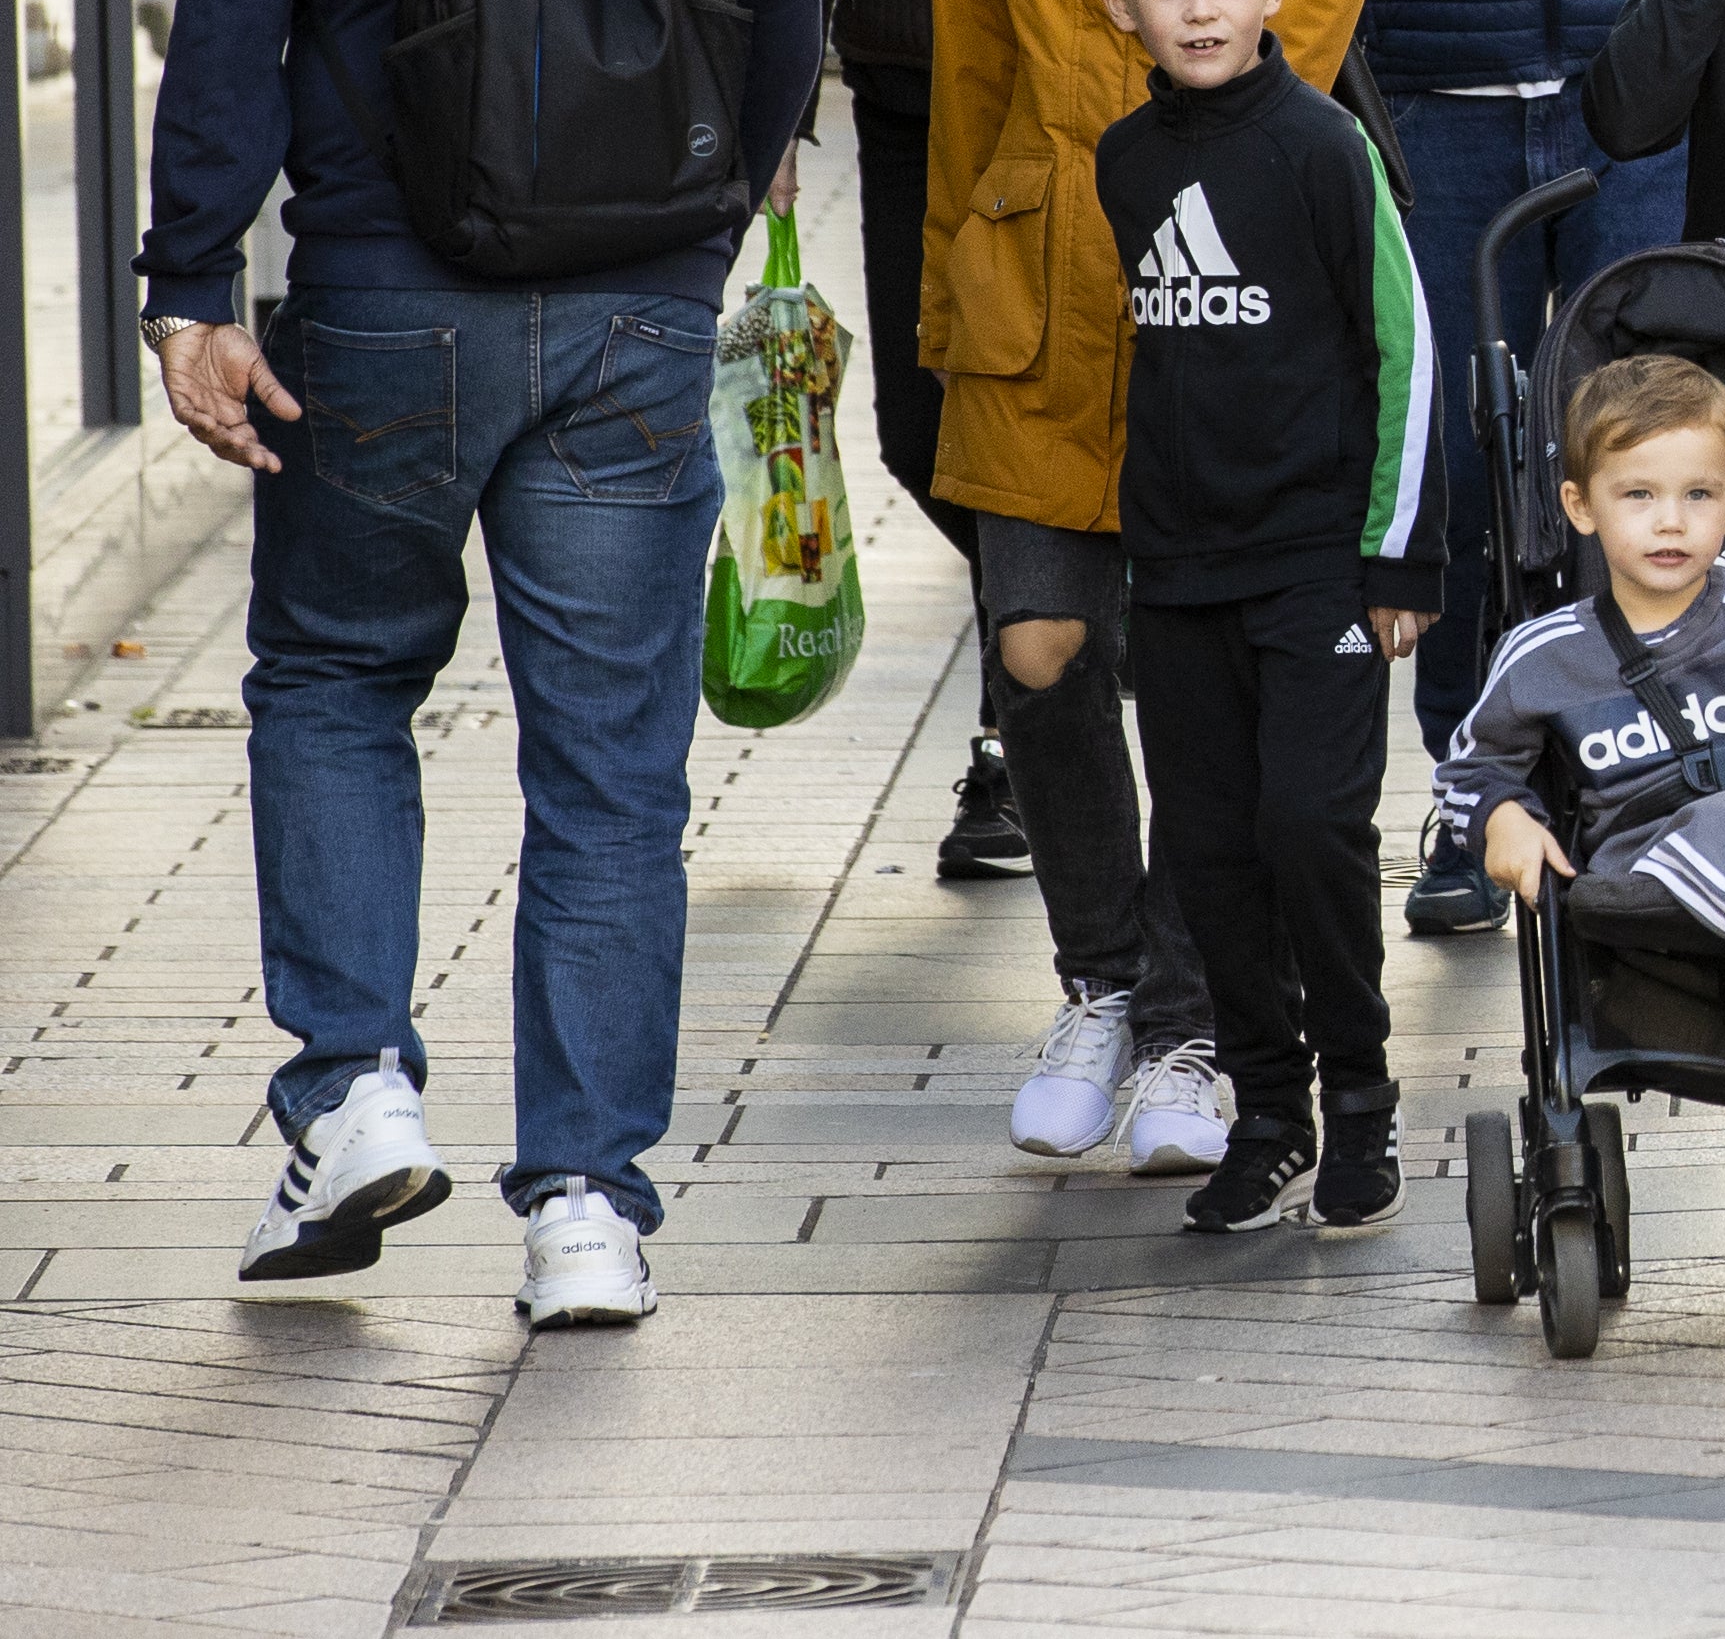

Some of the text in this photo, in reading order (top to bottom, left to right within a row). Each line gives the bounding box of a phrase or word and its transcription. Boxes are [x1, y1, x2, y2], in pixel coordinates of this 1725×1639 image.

[1132, 275, 1271, 327] adidas
[776, 616, 842, 659] Real
[1334, 641, 1372, 654] adidas
[561, 1241, 607, 1255] adidas
